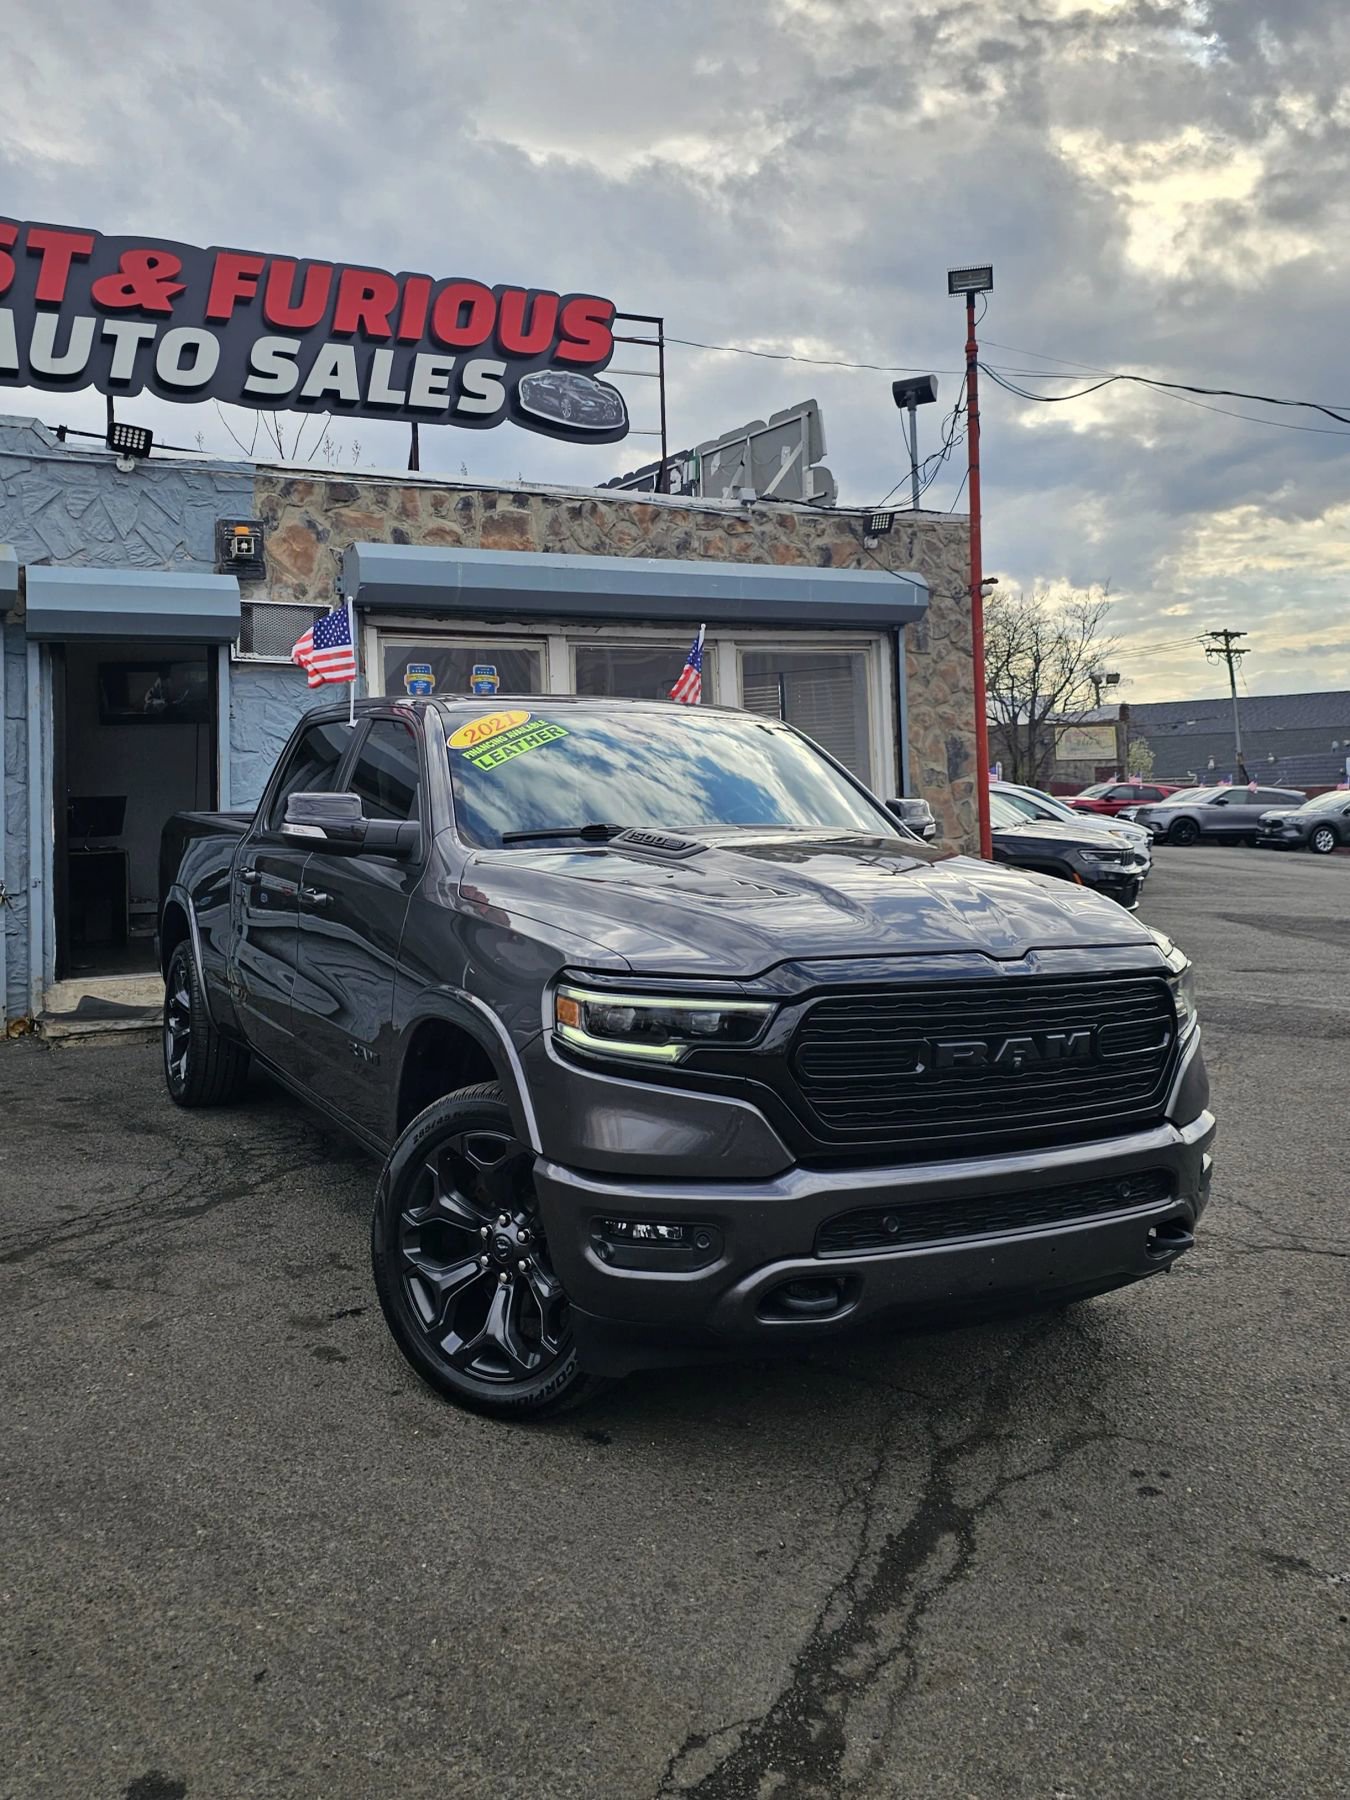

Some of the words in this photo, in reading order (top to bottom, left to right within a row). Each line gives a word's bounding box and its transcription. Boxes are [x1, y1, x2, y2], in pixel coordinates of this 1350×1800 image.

[92, 249, 188, 312] &
[207, 252, 615, 362] FURIOUS
[0, 307, 220, 387] UTO
[245, 335, 507, 414] SALES
[463, 735, 508, 760] FINANCING
[505, 719, 549, 741] AVAILABLE
[464, 711, 518, 744] 2021
[478, 726, 564, 769] LEATHER
[628, 831, 667, 845] 1500
[935, 1031, 1091, 1068] RAM
